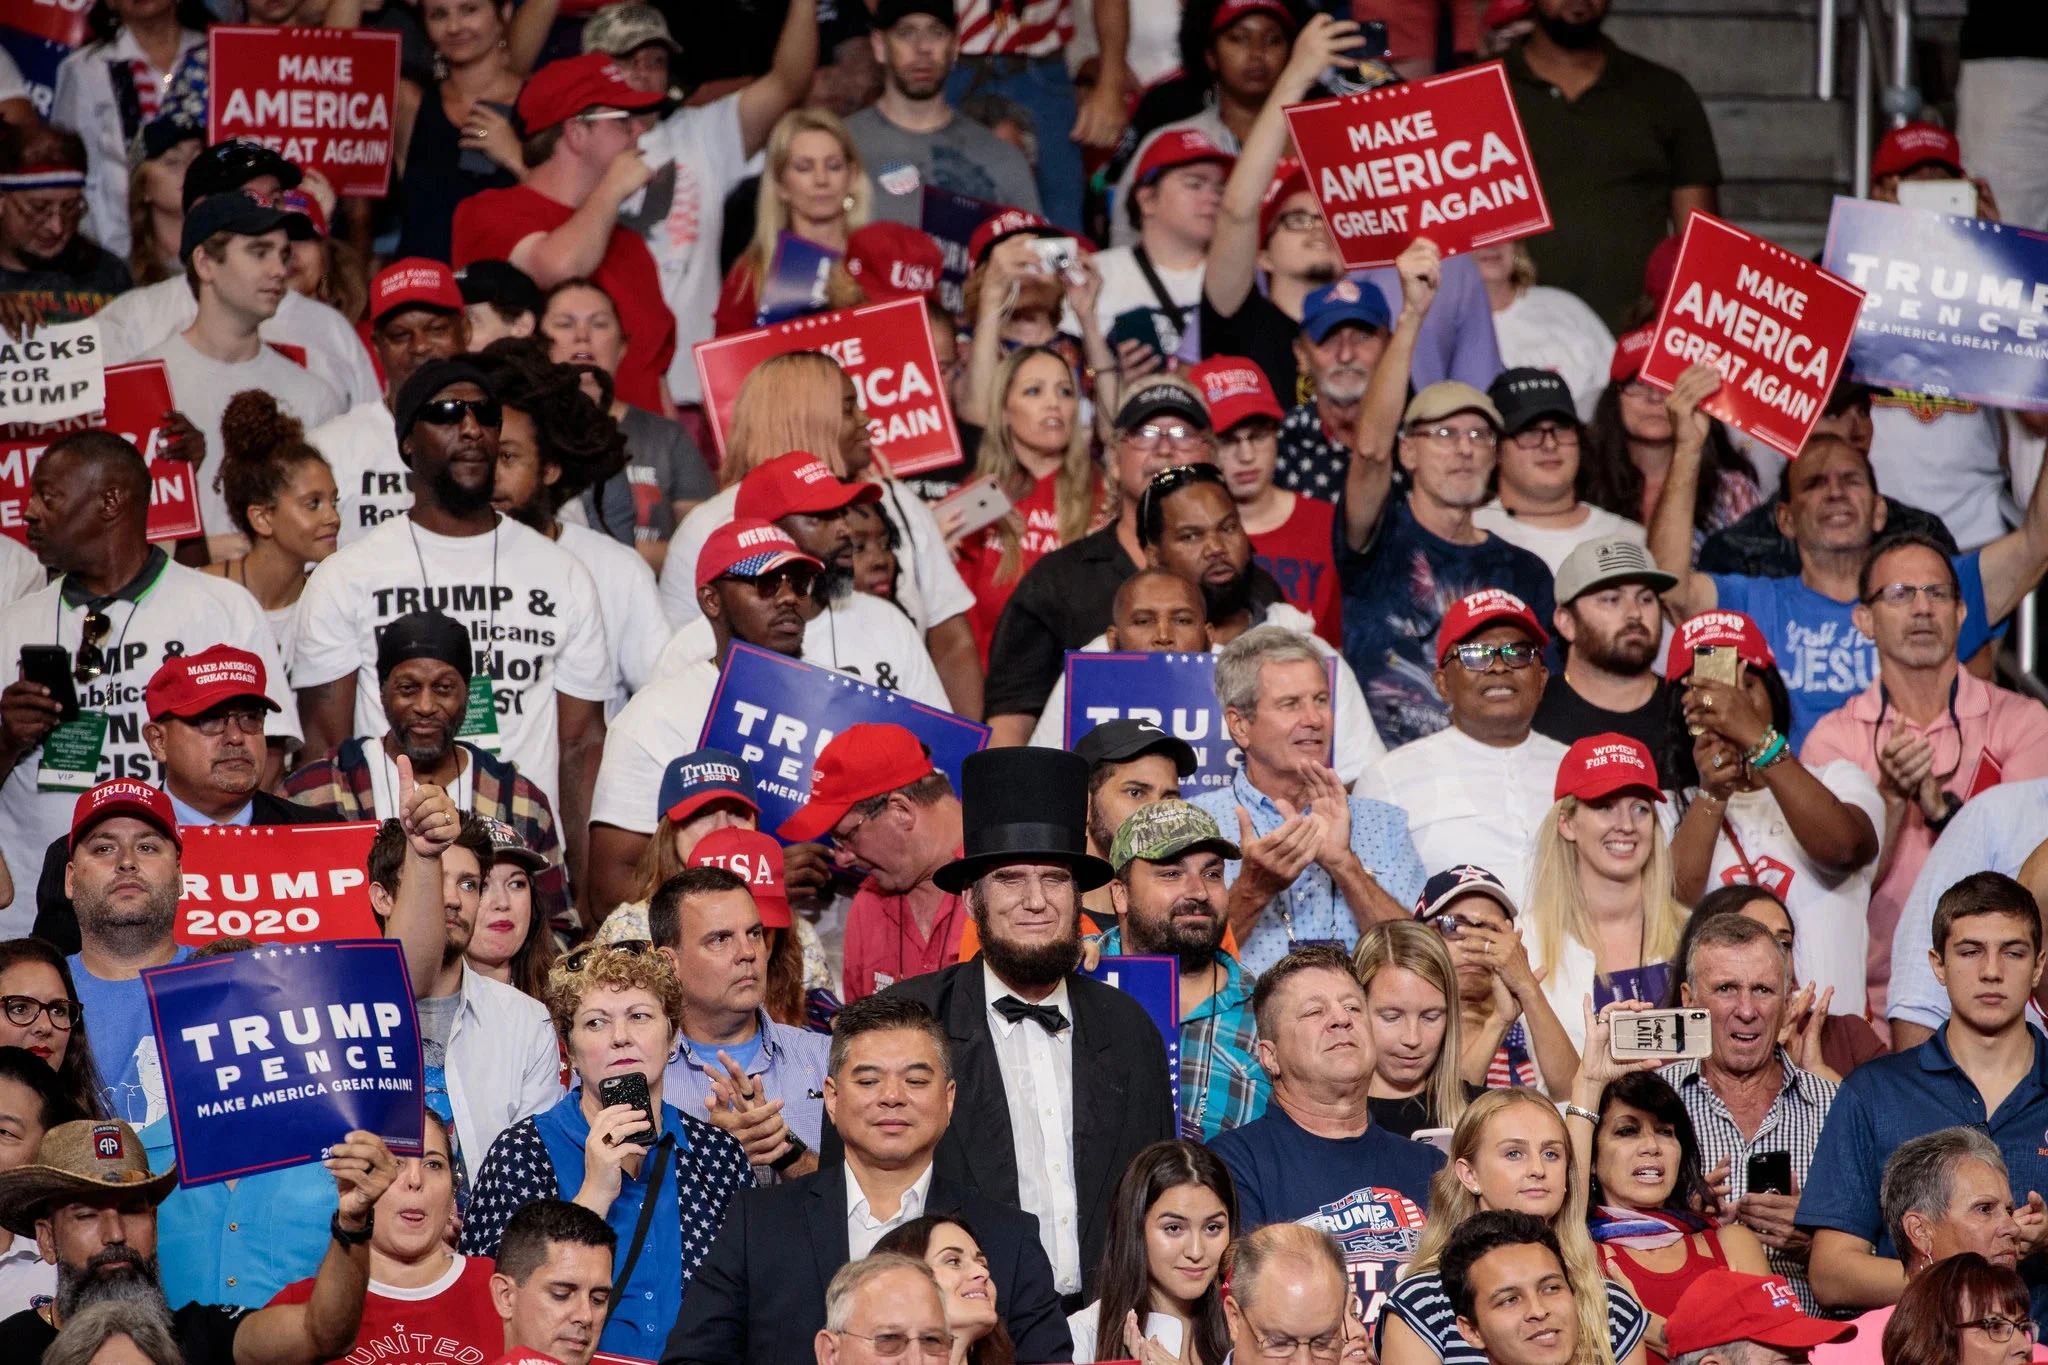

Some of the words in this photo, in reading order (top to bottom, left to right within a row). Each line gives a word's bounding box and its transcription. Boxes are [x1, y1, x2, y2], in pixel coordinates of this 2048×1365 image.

[278, 55, 353, 83] MAKE
[221, 88, 389, 130] AMERICA
[1347, 109, 1437, 153] MAKE
[226, 134, 318, 163] EAT
[323, 139, 387, 166] AGAIN
[1320, 131, 1518, 205] AMERICA
[1332, 205, 1409, 240] GREAT
[1419, 175, 1529, 231] AGAIN
[890, 260, 935, 290] USA
[1736, 263, 1809, 321] MAKE
[1863, 292, 2041, 340] PENCE
[0, 334, 97, 365] ACKS
[1673, 281, 1829, 389] AMERICA
[1880, 323, 1948, 344] AMERICA
[1951, 333, 2001, 352] GREAT
[830, 337, 866, 369] KE
[1664, 326, 1746, 384] GREAT
[1742, 367, 1818, 425] AGAIN
[0, 380, 90, 408] UMP
[868, 405, 942, 448] GAIN
[373, 585, 514, 617] TRUMP
[528, 589, 558, 618] &
[1463, 588, 1526, 612] TRUMP
[1682, 612, 1745, 642] TRUMP
[187, 662, 218, 676] MAKE
[218, 660, 257, 676] AMERICA
[195, 671, 229, 685] GREAT
[229, 671, 256, 685] AGAIN
[875, 661, 900, 691] &
[1778, 644, 1882, 694] JESU
[733, 699, 833, 759] TRU
[1585, 755, 1609, 770] FOR
[1610, 753, 1646, 770] TRUMP
[1592, 744, 1638, 757] WOMEN
[57, 772, 75, 781] VIP
[94, 753, 166, 784] CIST
[680, 762, 741, 783] Trump
[704, 773, 727, 783] 2020
[1201, 774, 1232, 786] GRE
[92, 783, 154, 803] TRUMP
[757, 779, 811, 805] AMERIC
[181, 867, 365, 900] RUMP
[186, 908, 321, 936] 2020
[182, 1003, 403, 1063] TRUMP
[1637, 1019, 1652, 1049] LATTE
[216, 1046, 397, 1091] PENCE
[197, 1097, 247, 1119] MAKE
[251, 1083, 328, 1109] AMERICA
[332, 1078, 375, 1093] GREAT
[377, 1077, 413, 1092] AGAIN!
[1318, 1204, 1387, 1232] RUMP
[1370, 1220, 1395, 1231] 2020
[1761, 1281, 1796, 1300] Tru
[345, 1333, 485, 1365] UNITED
